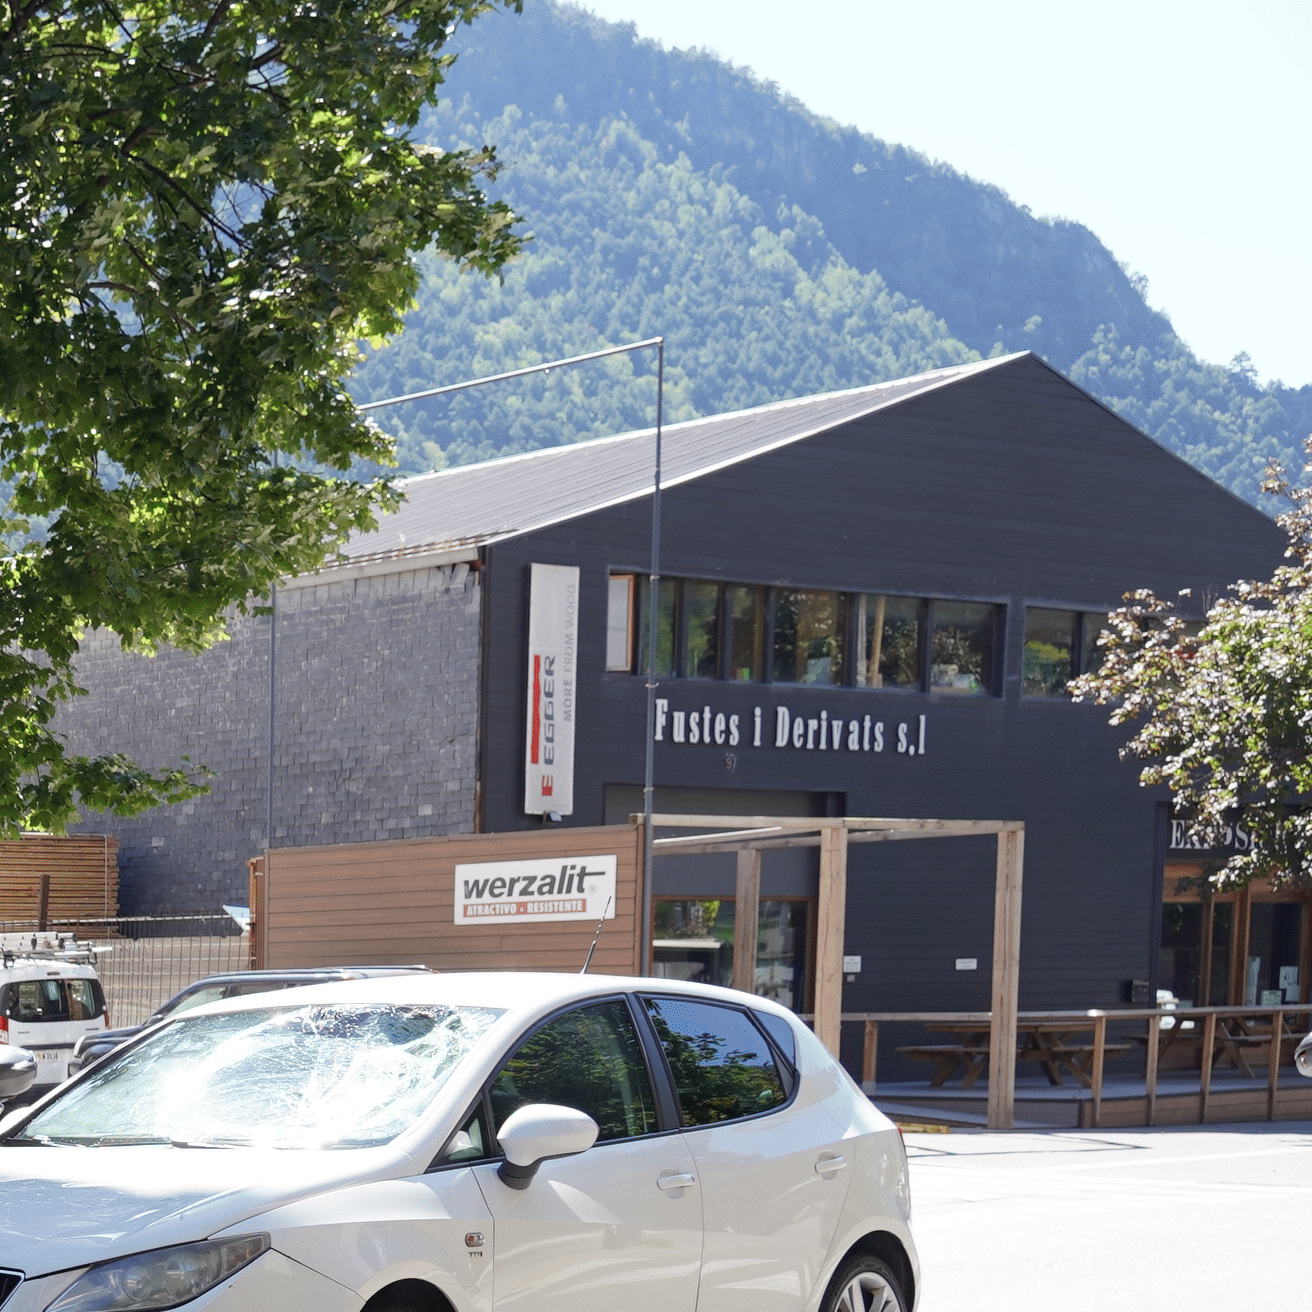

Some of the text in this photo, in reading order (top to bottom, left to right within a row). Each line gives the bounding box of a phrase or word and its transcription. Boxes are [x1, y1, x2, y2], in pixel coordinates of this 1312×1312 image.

[564, 633, 575, 673] FROM
[543, 655, 556, 766] EGGER
[562, 678, 573, 722] MORE
[654, 697, 740, 748] Fustes
[752, 699, 762, 748] i
[775, 705, 885, 755] Derivats
[463, 864, 607, 900] werzalit
[466, 899, 584, 917] ATRACTIVO RESISTENTE
